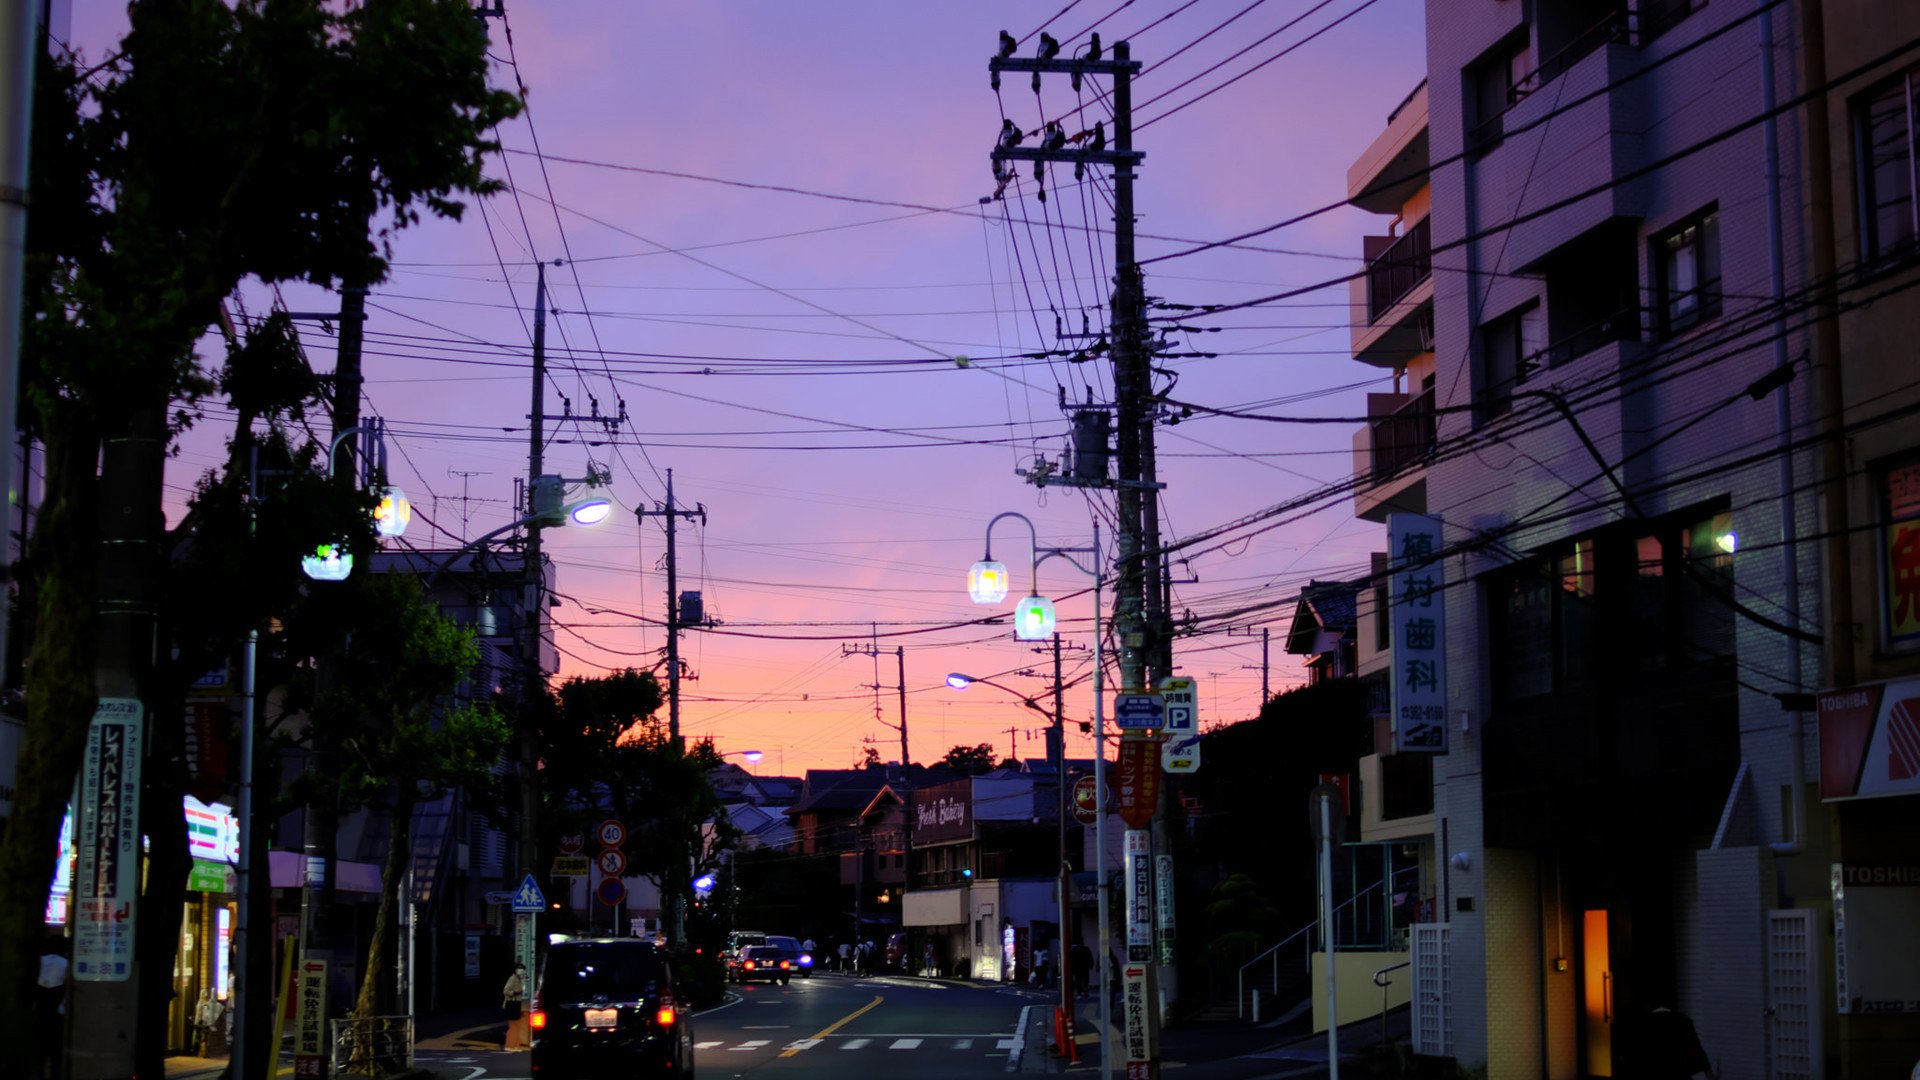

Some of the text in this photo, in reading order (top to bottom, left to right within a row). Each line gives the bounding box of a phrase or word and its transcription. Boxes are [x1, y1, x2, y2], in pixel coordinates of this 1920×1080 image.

[1820, 692, 1869, 712] TOSHIBA
[1173, 710, 1188, 727] P
[939, 797, 965, 826] Bakery
[604, 828, 620, 840] 40
[1128, 982, 1145, 1059] 運転免許試験場
